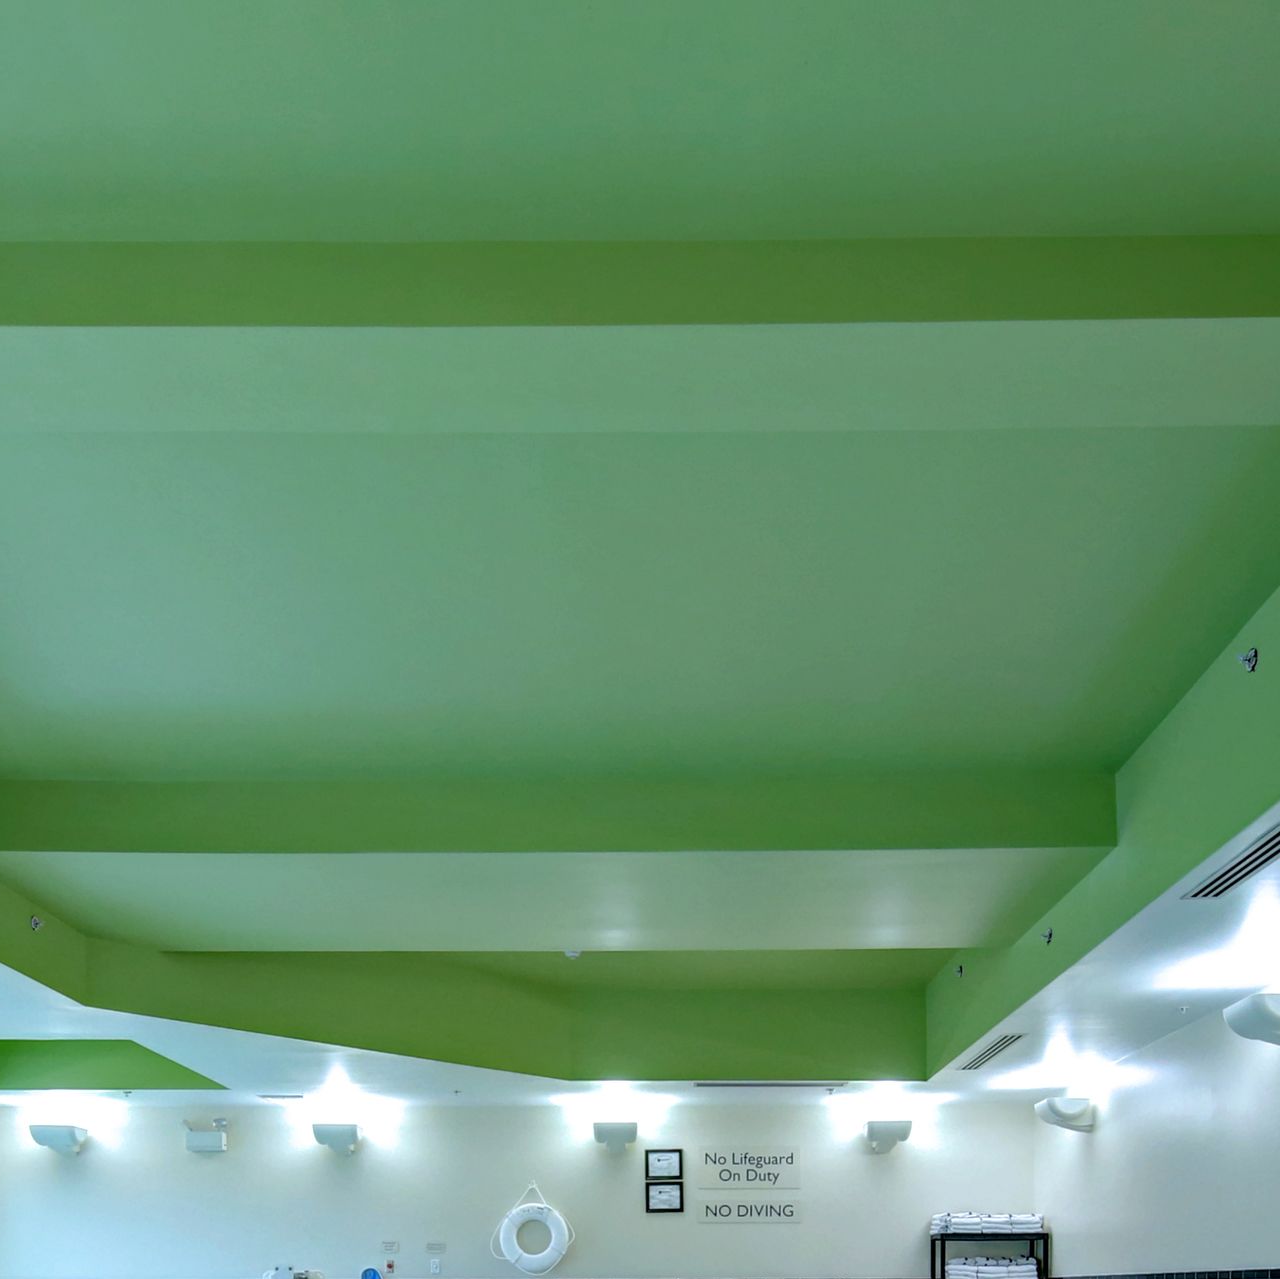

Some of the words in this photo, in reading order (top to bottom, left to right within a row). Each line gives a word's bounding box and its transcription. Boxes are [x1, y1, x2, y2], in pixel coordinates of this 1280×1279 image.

[704, 1152, 727, 1166] No
[732, 1152, 794, 1168] Lifeguard
[719, 1168, 741, 1182] On
[746, 1168, 780, 1185] Duty
[705, 1204, 732, 1217] NO
[737, 1204, 794, 1218] DIVING
